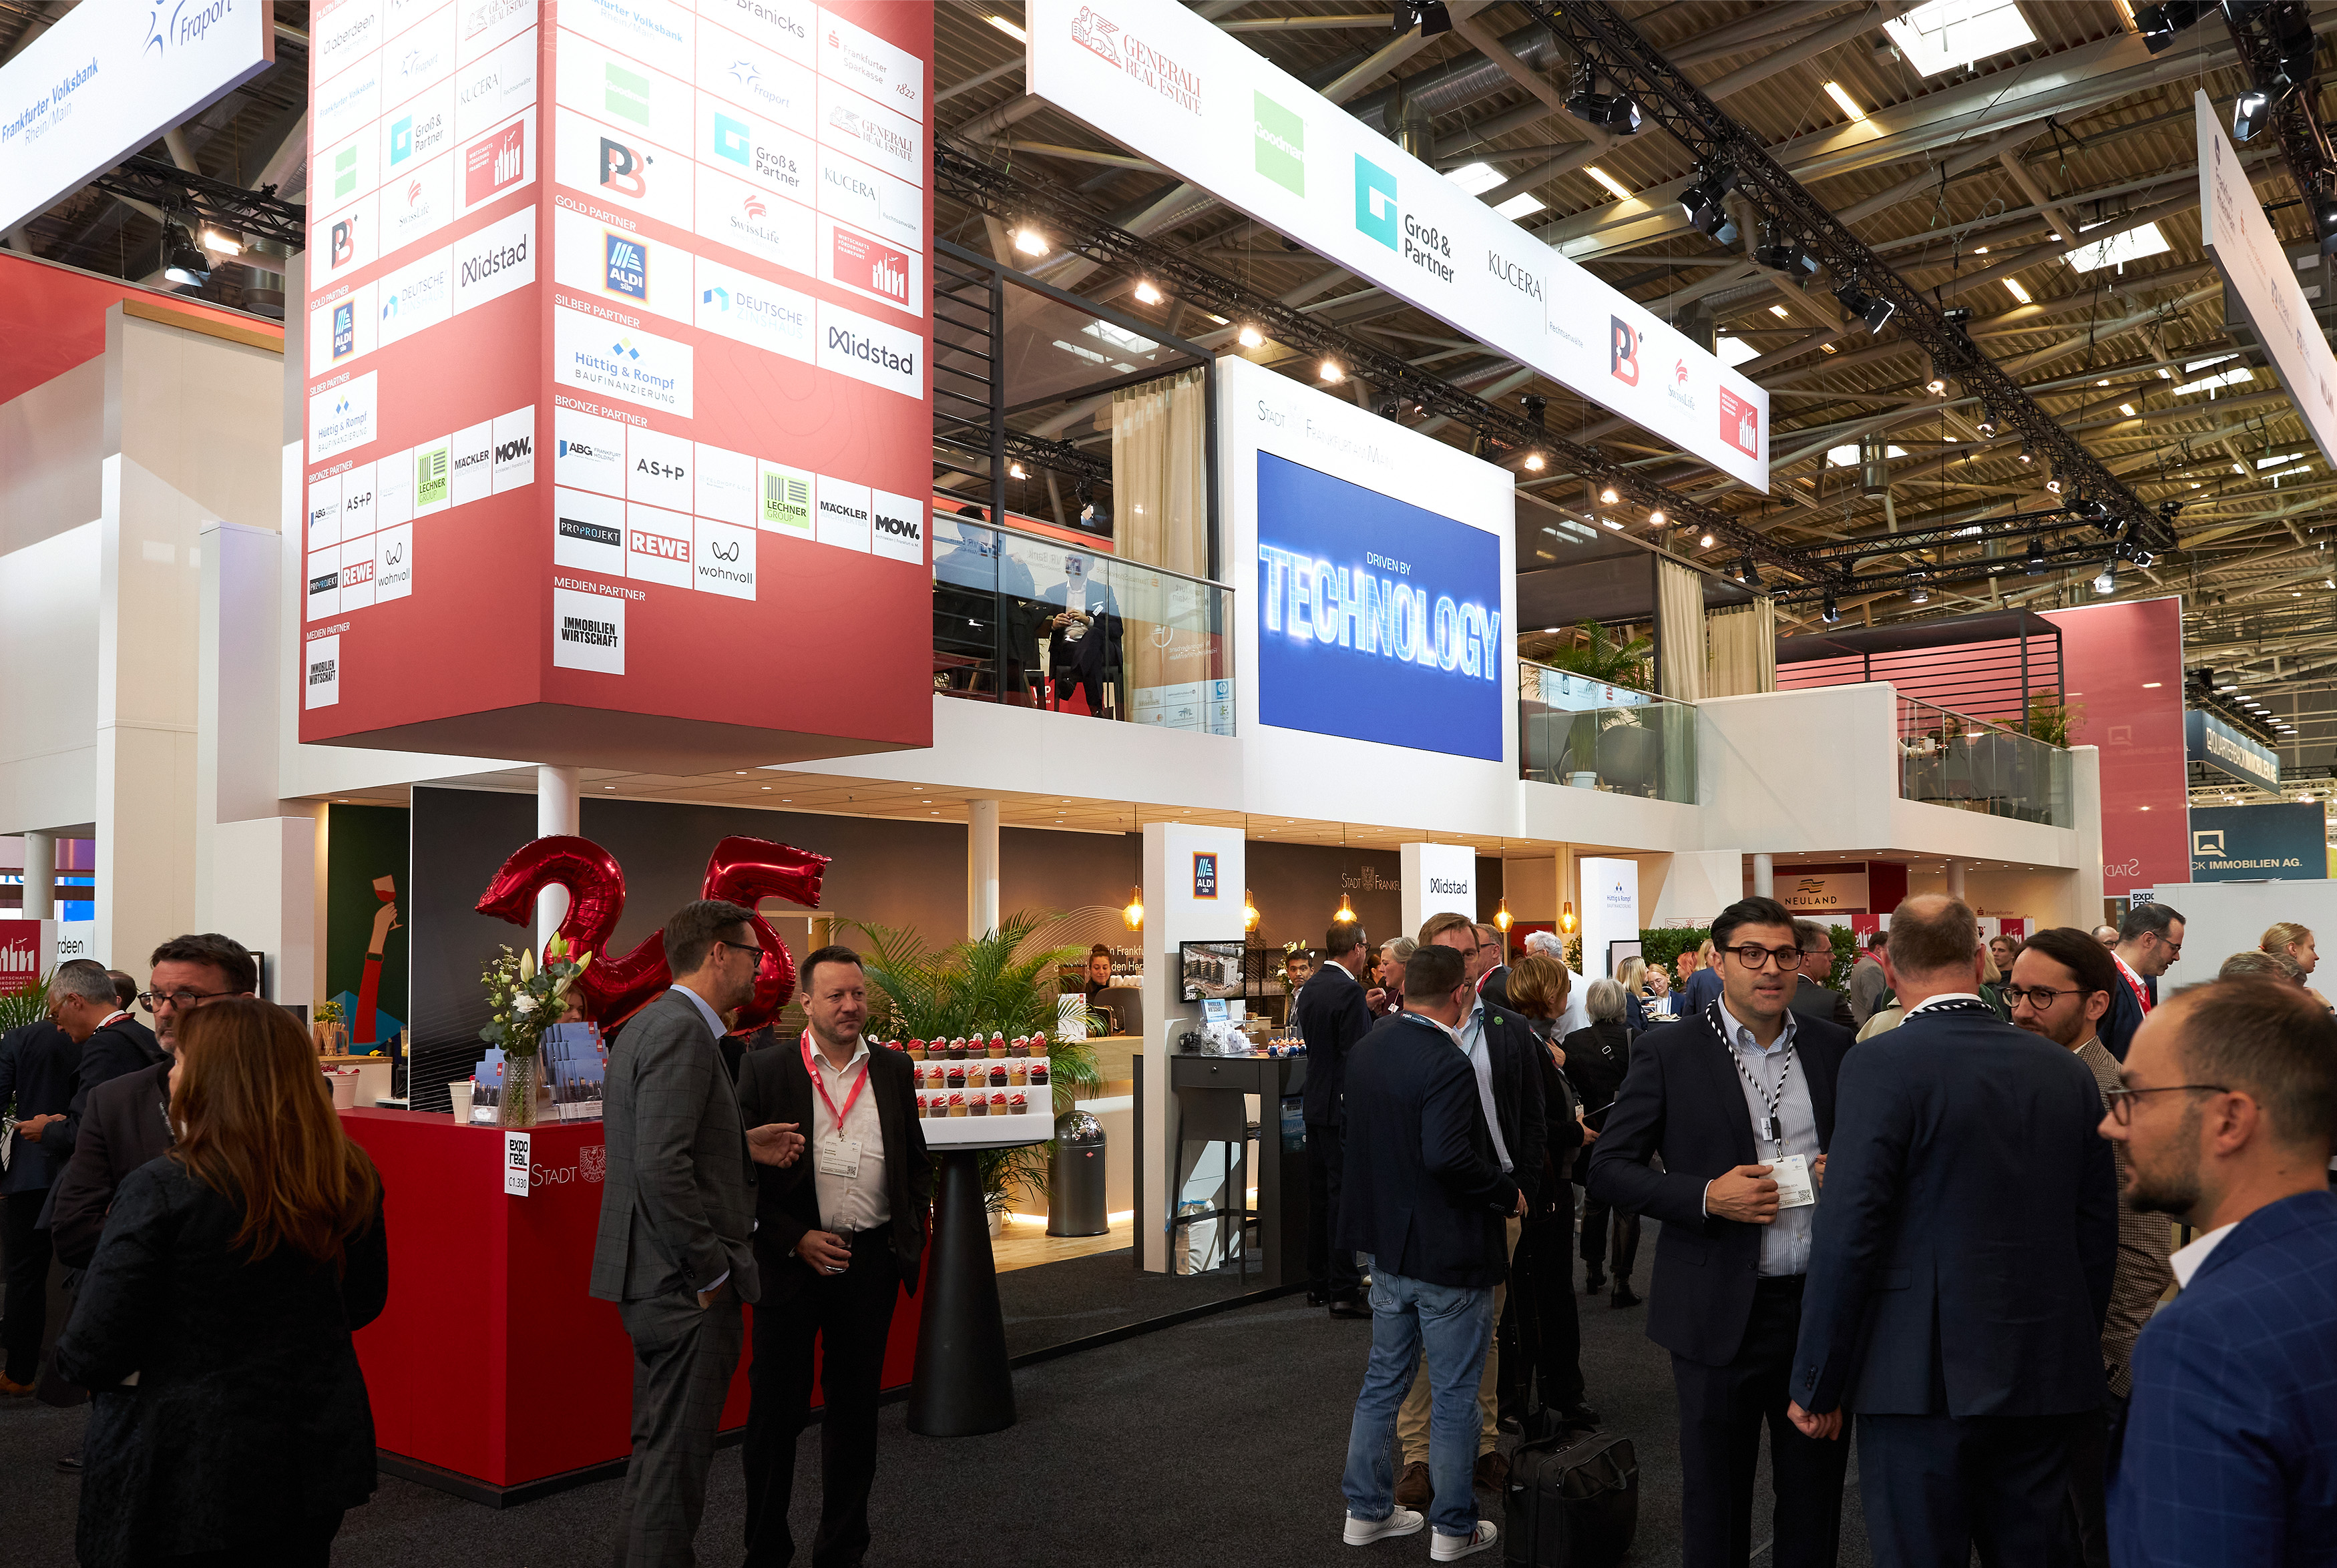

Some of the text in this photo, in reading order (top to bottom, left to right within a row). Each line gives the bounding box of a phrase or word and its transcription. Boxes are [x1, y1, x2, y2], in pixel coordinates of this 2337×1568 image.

[181, 0, 232, 45] Fraport
[316, 1, 334, 20] PLATIN
[332, 14, 374, 49] aberdeen
[601, 9, 656, 41] Rhein/Main
[634, 11, 683, 43] Volksbank
[415, 53, 438, 75] Fraport
[844, 44, 887, 74] Frankfurter
[1124, 33, 1201, 96] GENERALI
[461, 73, 498, 105] KUCERA
[843, 57, 915, 100] Sparkasse 1822
[1124, 57, 1202, 116] REAL ESTATE
[2, 57, 98, 144] Frankfurter Volksbank
[320, 95, 347, 118] Frankfurter
[349, 78, 375, 100] Volksbank
[754, 84, 790, 108] Fraport
[25, 101, 71, 146] Rhein/Main
[415, 114, 442, 138] Groß &
[861, 119, 913, 152] GENERALI
[415, 129, 443, 153] Partner
[863, 133, 913, 163] REAL ESTATE
[1254, 119, 1304, 163] Goodman
[757, 146, 797, 174] Groß &
[756, 160, 800, 188] Partner
[825, 168, 917, 232] KUCERA Rechtsanwälte
[555, 194, 636, 232] GOLD PARTNER
[838, 233, 870, 250] WIRTSCHAFTS
[838, 239, 866, 254] FÖRDERUNG
[1404, 214, 1452, 258] Groß &
[838, 246, 865, 260] FRANKFURT
[1404, 242, 1454, 284] Partner
[402, 271, 444, 301] DEUTSCHE
[610, 268, 643, 288] ALDI
[620, 282, 633, 293] SÜD
[310, 285, 349, 310] GOLD PARTNER
[736, 292, 803, 326] DEUTSCHE
[1488, 250, 1584, 348] KUCERA Rechtsanwälte
[555, 294, 640, 328] SILBER PARTNER
[736, 306, 803, 340] ZINSHAUS
[335, 331, 352, 348] ALDI
[575, 352, 674, 390] Hüttig & Rompf
[310, 372, 350, 397] SILBER PARTNER
[575, 370, 675, 404] BAUFINANZIERUNG
[555, 395, 648, 428] BRONZE PARTNER
[318, 411, 367, 440] Hüttig & Rompf
[1258, 400, 1285, 428] STADT
[1306, 419, 1351, 455] FRANKFURT
[1367, 445, 1394, 470] MAIN
[318, 427, 367, 452] BAUFINANZIERUNG
[569, 442, 592, 456] ABG
[594, 447, 621, 458] FRANKFURT
[455, 450, 489, 469] MÄCKLER
[455, 461, 489, 478] ARCHITEKTEN
[594, 453, 615, 462] HOLDING
[637, 459, 684, 480] AS+P
[308, 460, 353, 483] BRONZE PARTNER
[419, 478, 445, 493] LECHNER
[419, 491, 437, 503] GROUP
[314, 509, 325, 519] ABG
[767, 500, 807, 517] LECHNER
[767, 509, 794, 523] GROUP
[820, 501, 867, 521] MÄCKLER
[820, 511, 867, 528] ARCHITEKTEN
[561, 522, 619, 542] PROPROJEKT
[875, 514, 920, 541] MOW.
[875, 533, 895, 543] Architekten
[632, 532, 688, 561] REWE
[343, 561, 373, 586] REWE
[698, 565, 753, 584] wohnvoll
[1366, 551, 1412, 575] DRIVEN BY
[378, 568, 410, 587] wohnvoll
[554, 576, 646, 601] MEDIEN PARTNER
[1259, 543, 1501, 681] TECHNOLOGY
[306, 622, 350, 641] MEDIEN PARTNER
[561, 628, 618, 647] WIRTSCHAFT
[564, 616, 616, 635] IMMOBILIEN
[309, 670, 336, 686] WIRTSCHAFT
[310, 660, 335, 675] IMMOBILIEN
[2209, 858, 2280, 870] IMMOBILIEN
[2282, 858, 2302, 866] AG.
[1197, 879, 1214, 888] ALDI
[1341, 872, 1402, 891] STADT FRANKFU
[1785, 896, 1837, 905] NEULAND
[57, 936, 83, 954] rdeen
[1117, 945, 1143, 956] Frankfu
[1111, 962, 1143, 971] den Her
[509, 1139, 527, 1155] expo
[509, 1177, 527, 1189] C1.330
[530, 1163, 578, 1186] STADT
